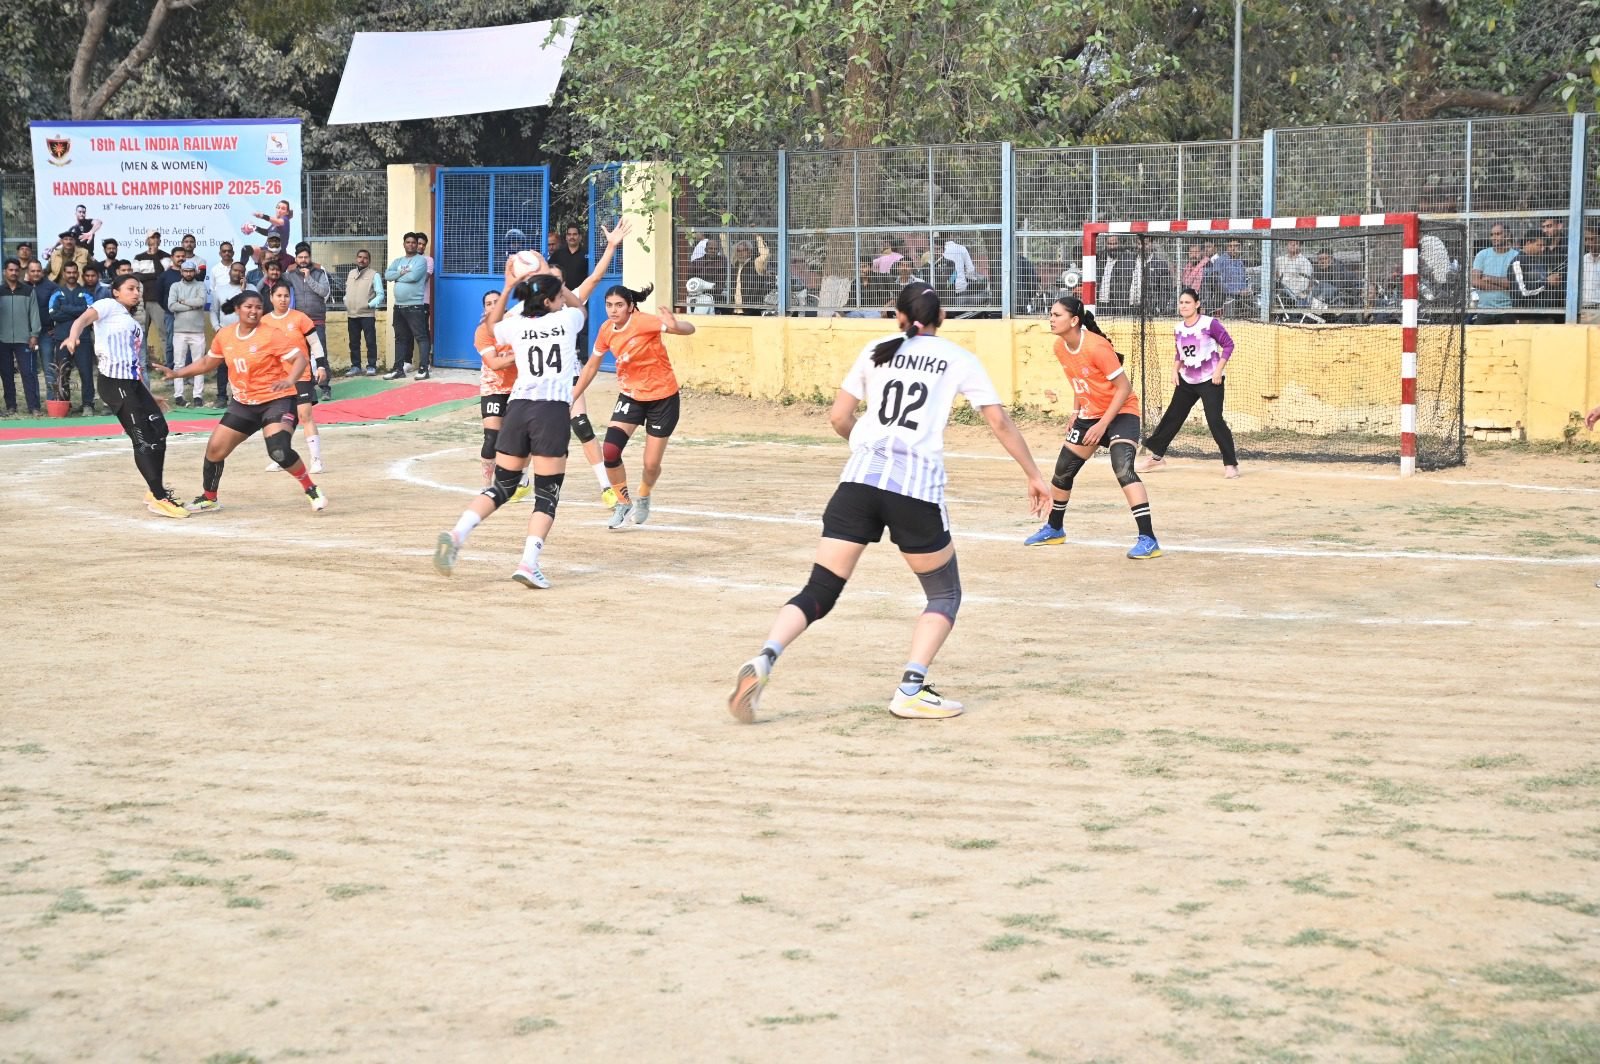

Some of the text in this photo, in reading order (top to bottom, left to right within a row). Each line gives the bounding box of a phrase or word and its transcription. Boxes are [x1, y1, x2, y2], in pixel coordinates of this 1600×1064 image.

[90, 136, 238, 151] 18th ALL INDIA RAILWAY
[121, 160, 208, 172] (MEN & WOMEN)
[53, 180, 282, 196] HANDBALL CHAMPIONSHIP 2025-26
[115, 203, 143, 212] February
[145, 203, 161, 211] 2026
[162, 203, 170, 211] to
[184, 202, 212, 211] February
[129, 226, 150, 235] Und
[173, 226, 194, 237] Aegis
[197, 225, 205, 235] of
[163, 238, 207, 247] Proon
[521, 326, 566, 340] JASSI
[1182, 345, 1196, 357] 22
[233, 358, 248, 373] 10
[527, 344, 562, 378] 04
[487, 402, 500, 414] 06
[614, 401, 630, 415] 04
[878, 379, 929, 431] 02
